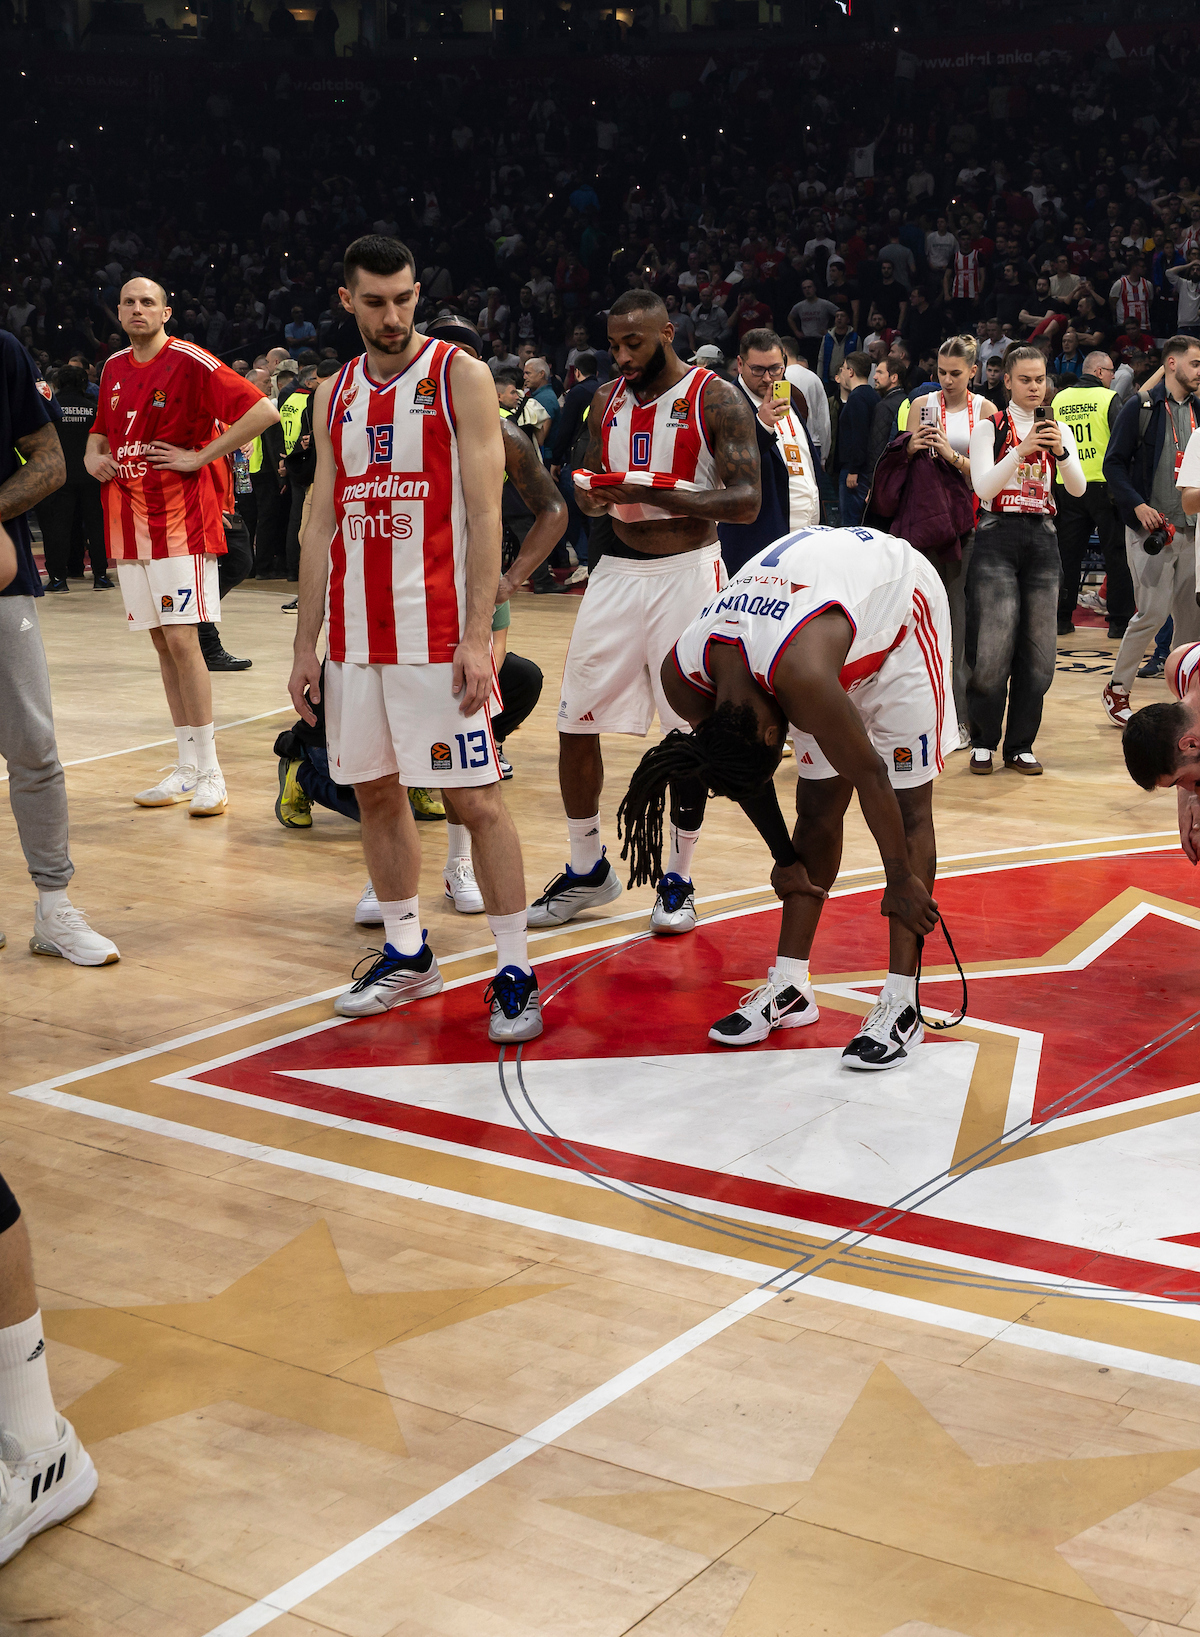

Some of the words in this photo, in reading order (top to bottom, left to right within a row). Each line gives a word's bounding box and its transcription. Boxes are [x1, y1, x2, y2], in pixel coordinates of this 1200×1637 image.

[125, 410, 137, 436] 7
[1065, 413, 1091, 422] SECURITY
[366, 424, 395, 464] 13
[632, 432, 651, 466] 0
[341, 475, 430, 502] meridian
[348, 509, 413, 541] mts
[178, 588, 192, 612] 7
[455, 729, 489, 769] 13
[918, 733, 929, 767] 1
